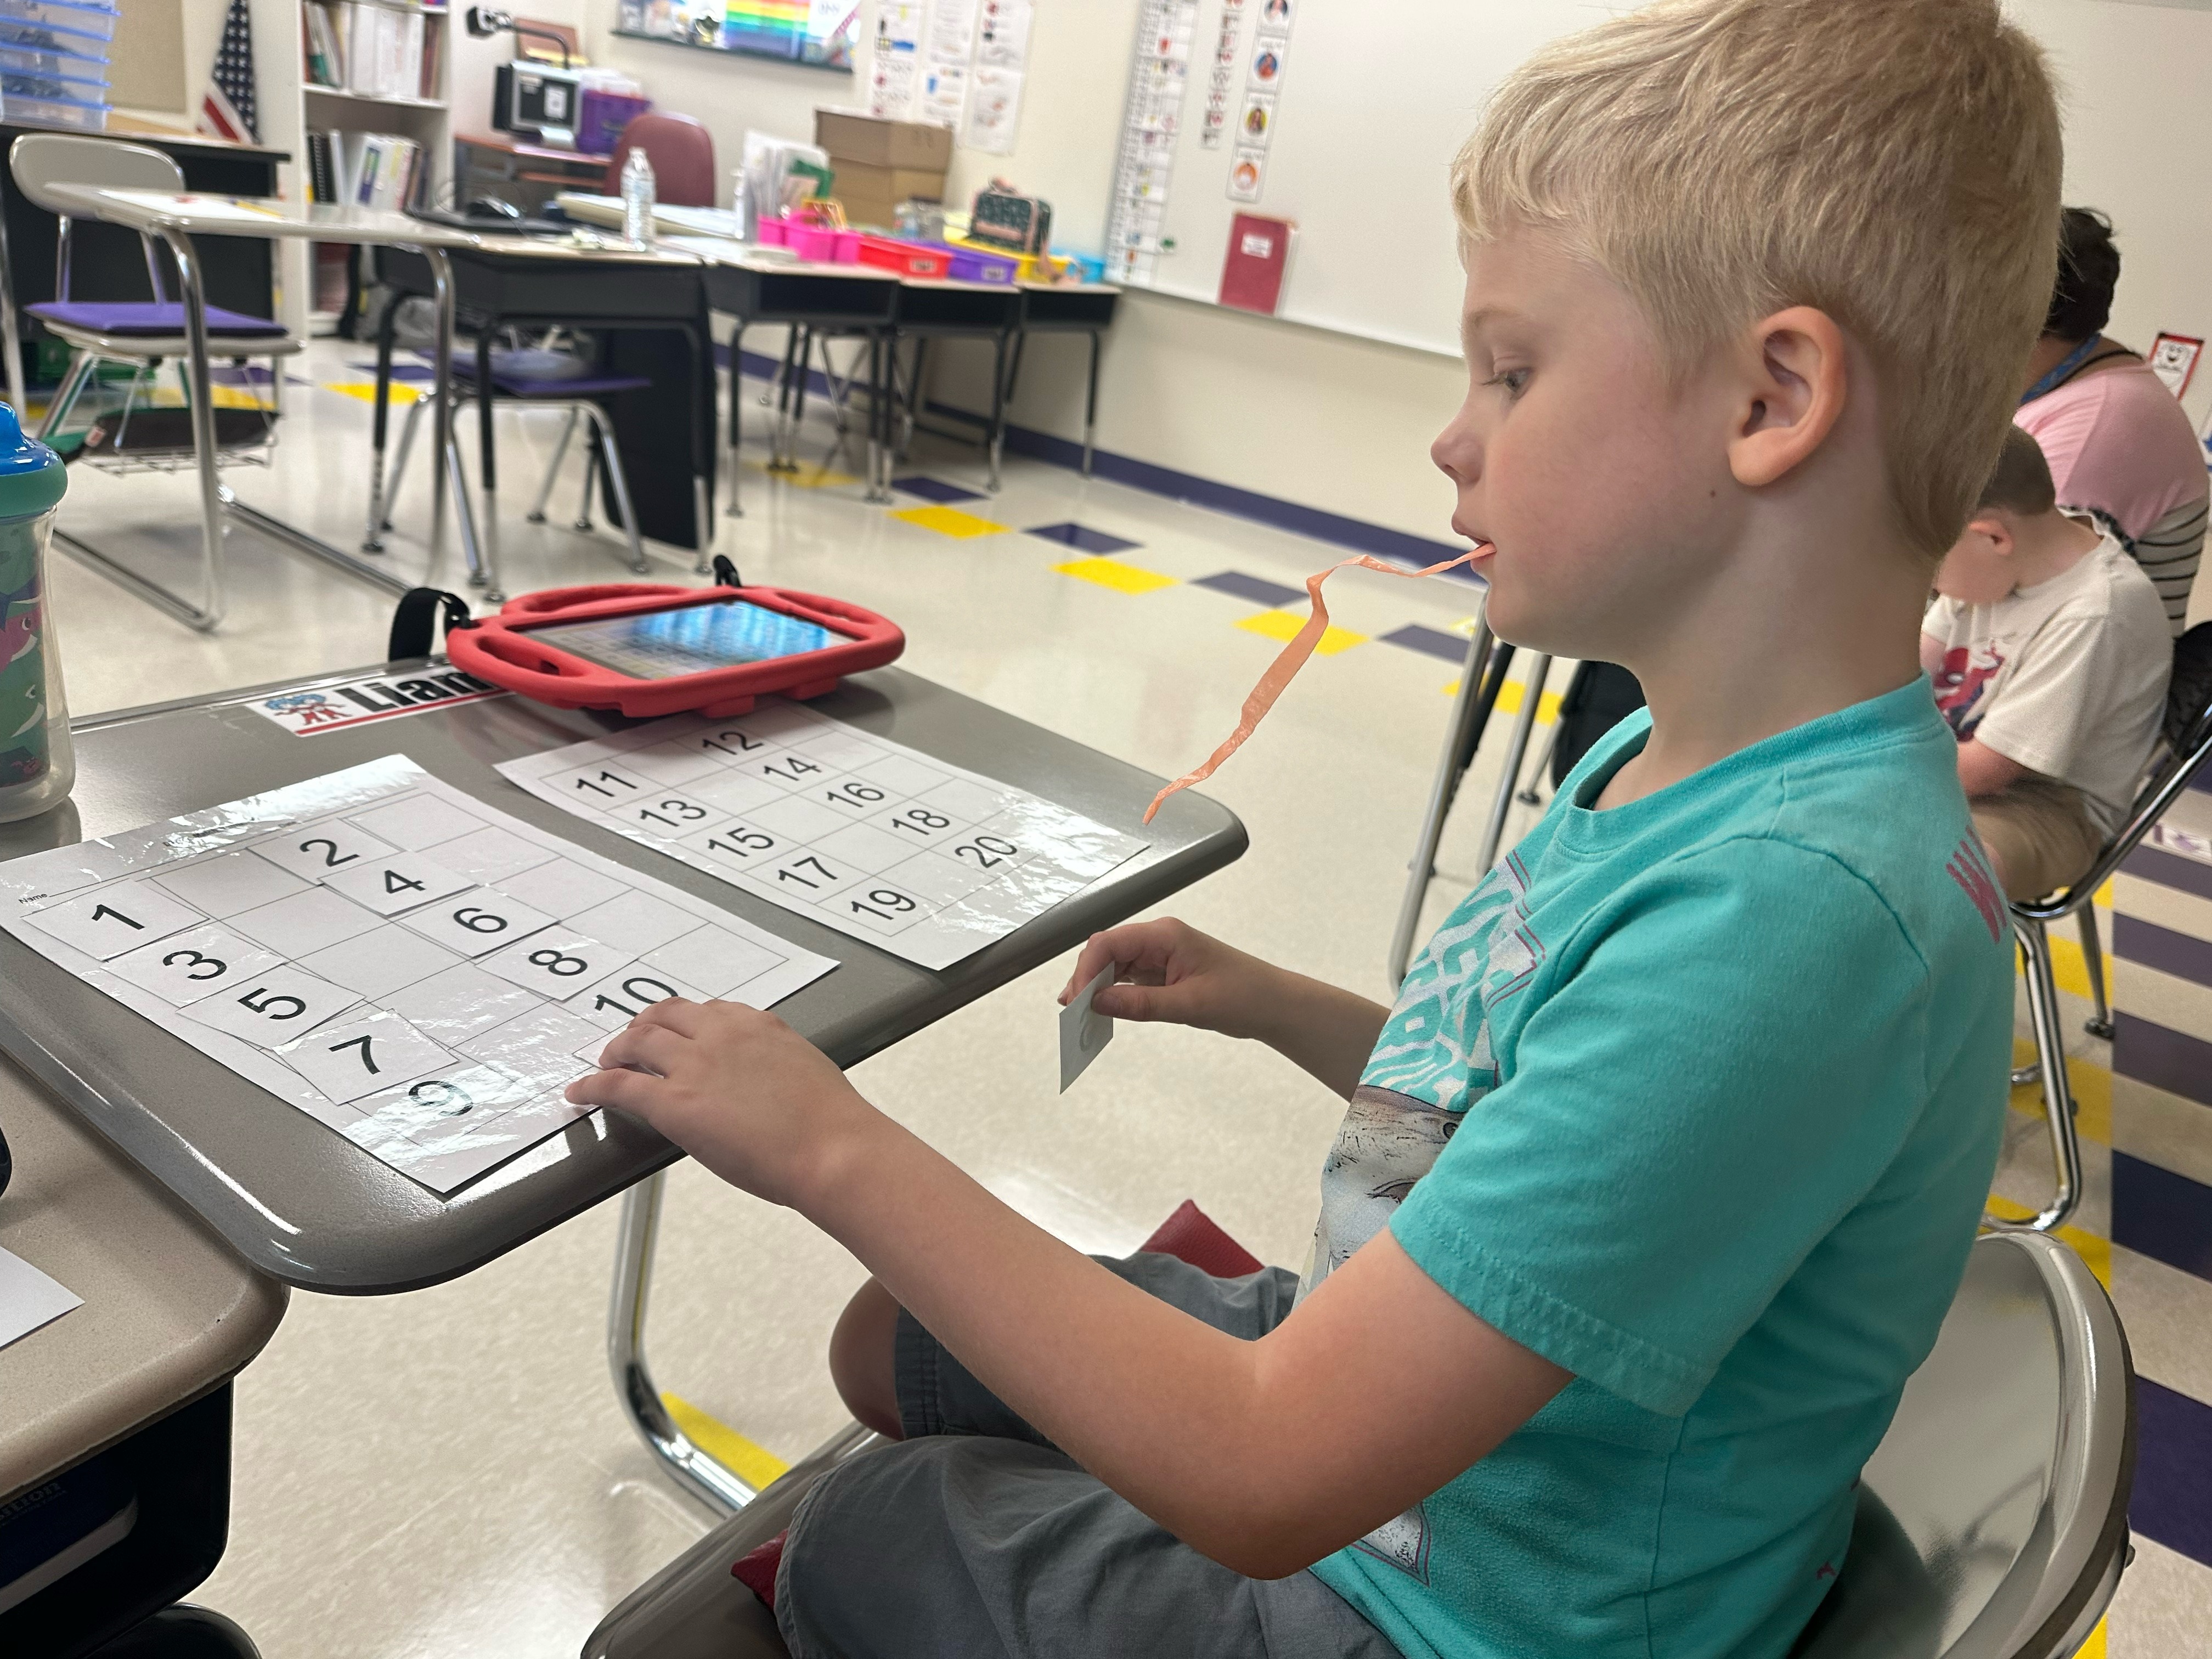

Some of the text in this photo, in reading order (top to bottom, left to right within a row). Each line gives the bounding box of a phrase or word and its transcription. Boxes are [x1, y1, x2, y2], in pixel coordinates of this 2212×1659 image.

[702, 729, 765, 757] 12
[575, 770, 638, 798] 11
[763, 757, 822, 782] 14
[826, 782, 885, 809] 16
[640, 799, 707, 828] 13
[891, 809, 951, 836] 18
[299, 838, 360, 867] 2
[708, 827, 775, 859] 15
[954, 836, 1018, 868] 20
[384, 870, 426, 894] 4
[778, 856, 839, 889] 17
[18, 893, 48, 904] Name
[850, 889, 917, 921] 19
[91, 904, 146, 931] 1
[453, 907, 509, 934] 6
[162, 950, 228, 981] 3
[528, 949, 589, 977] 8
[236, 987, 307, 1020] 5
[594, 977, 680, 1018] 10
[328, 1034, 382, 1075] 7
[408, 1080, 474, 1116] 9
